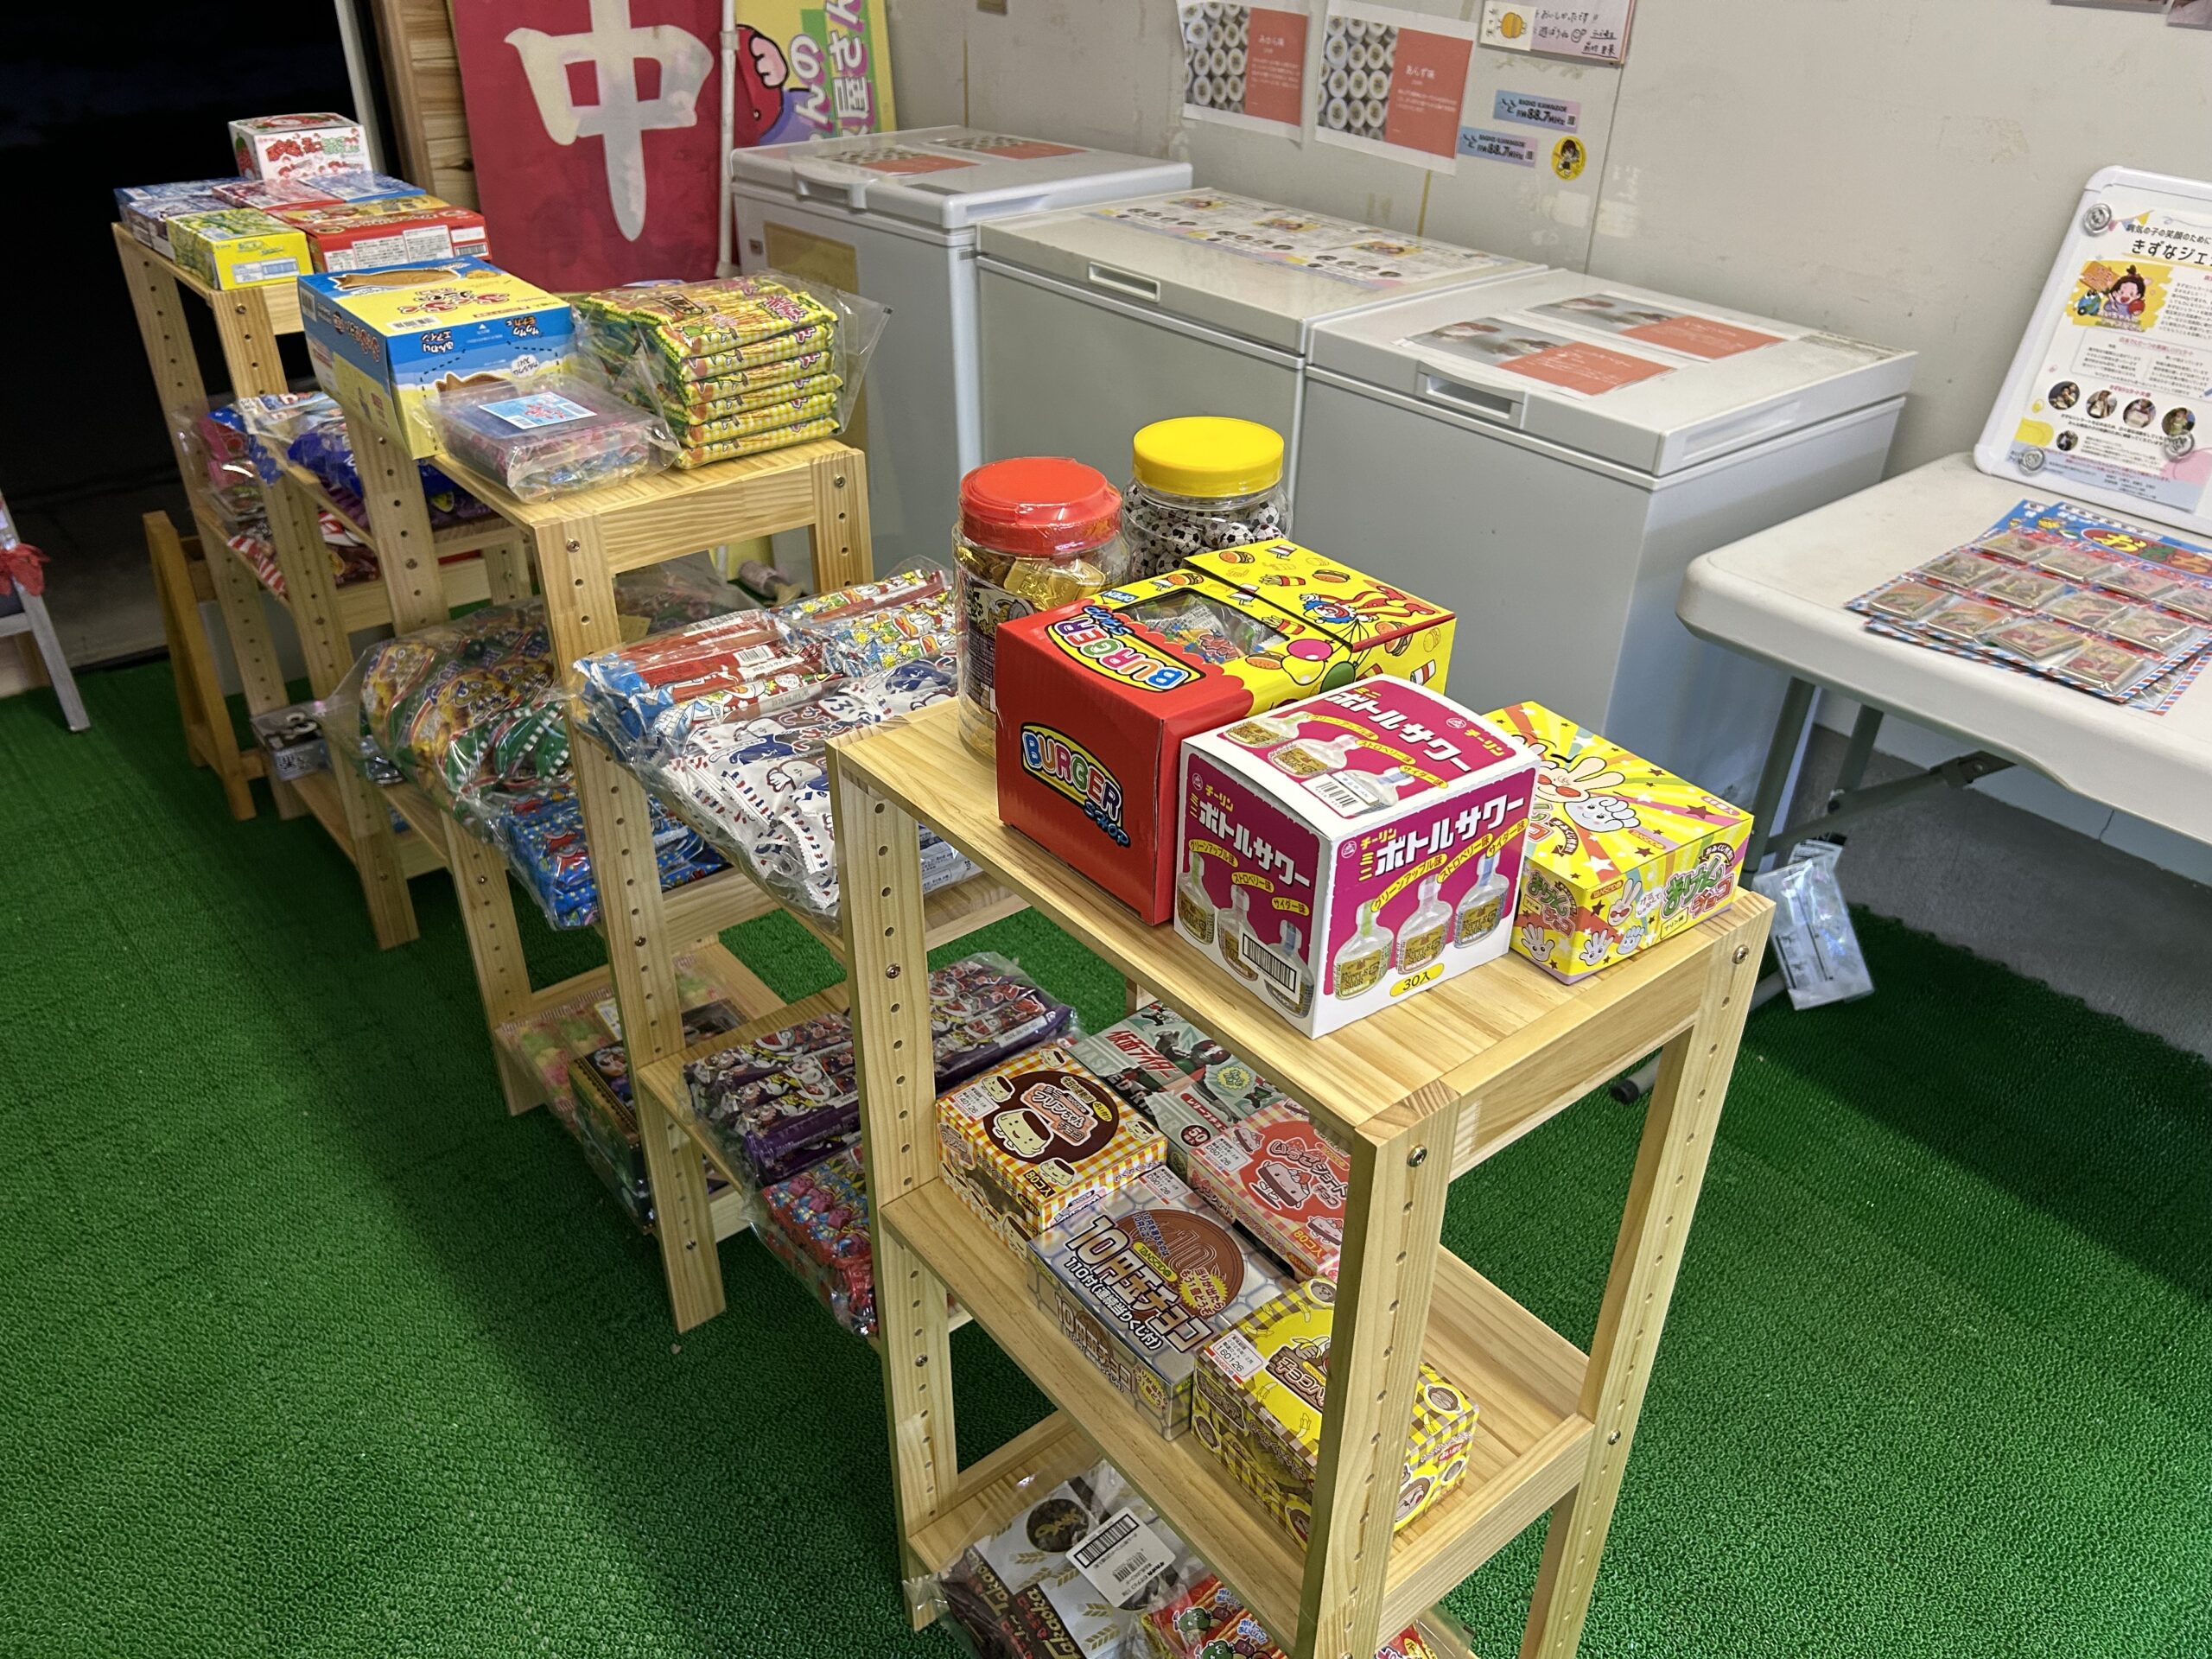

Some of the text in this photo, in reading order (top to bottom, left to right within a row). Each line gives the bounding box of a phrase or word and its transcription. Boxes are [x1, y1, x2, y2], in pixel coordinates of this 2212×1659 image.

[826, 0, 869, 137] 屋さん
[790, 35, 830, 141] んの
[504, 0, 714, 242] 中
[2132, 239, 2212, 266] きずなジェ
[1105, 590, 1136, 603] OPEN
[1058, 617, 1189, 689] BURGER
[1326, 690, 1471, 772] ボトルサワー
[1463, 728, 1505, 757] チーリン
[1357, 740, 1415, 765] ストロベリー味
[1022, 731, 1122, 821] BURGER
[1402, 766, 1447, 788] サイダー味
[1205, 785, 1234, 812] チーリン
[1084, 801, 1130, 846] SHOP
[1360, 827, 1397, 850] チーリン
[1374, 793, 1525, 877] ボトルサワー
[1487, 821, 1526, 855] サイダー味
[1198, 800, 1311, 887] ボトルサワー
[1439, 834, 1491, 881] ストロベリー味
[1233, 874, 1273, 891] ストロベリー味
[1373, 855, 1443, 910] グリーンアップル味
[1691, 874, 1733, 918] チョコ
[1273, 899, 1306, 915] サイダー味
[1402, 971, 1431, 991] 30入
[1031, 1087, 1086, 1132] プリンちゃん
[1185, 1096, 1229, 1134] レリーフチョ
[1058, 1120, 1084, 1141] チョコ
[1188, 1126, 1208, 1142] 50
[1026, 1171, 1054, 1198] 80コ入
[1313, 1183, 1341, 1208] チョコ
[1294, 1229, 1325, 1259] 80コ入
[1138, 1244, 1175, 1281] TANSEIDO
[1065, 1214, 1214, 1354] 10円玉チョコ
